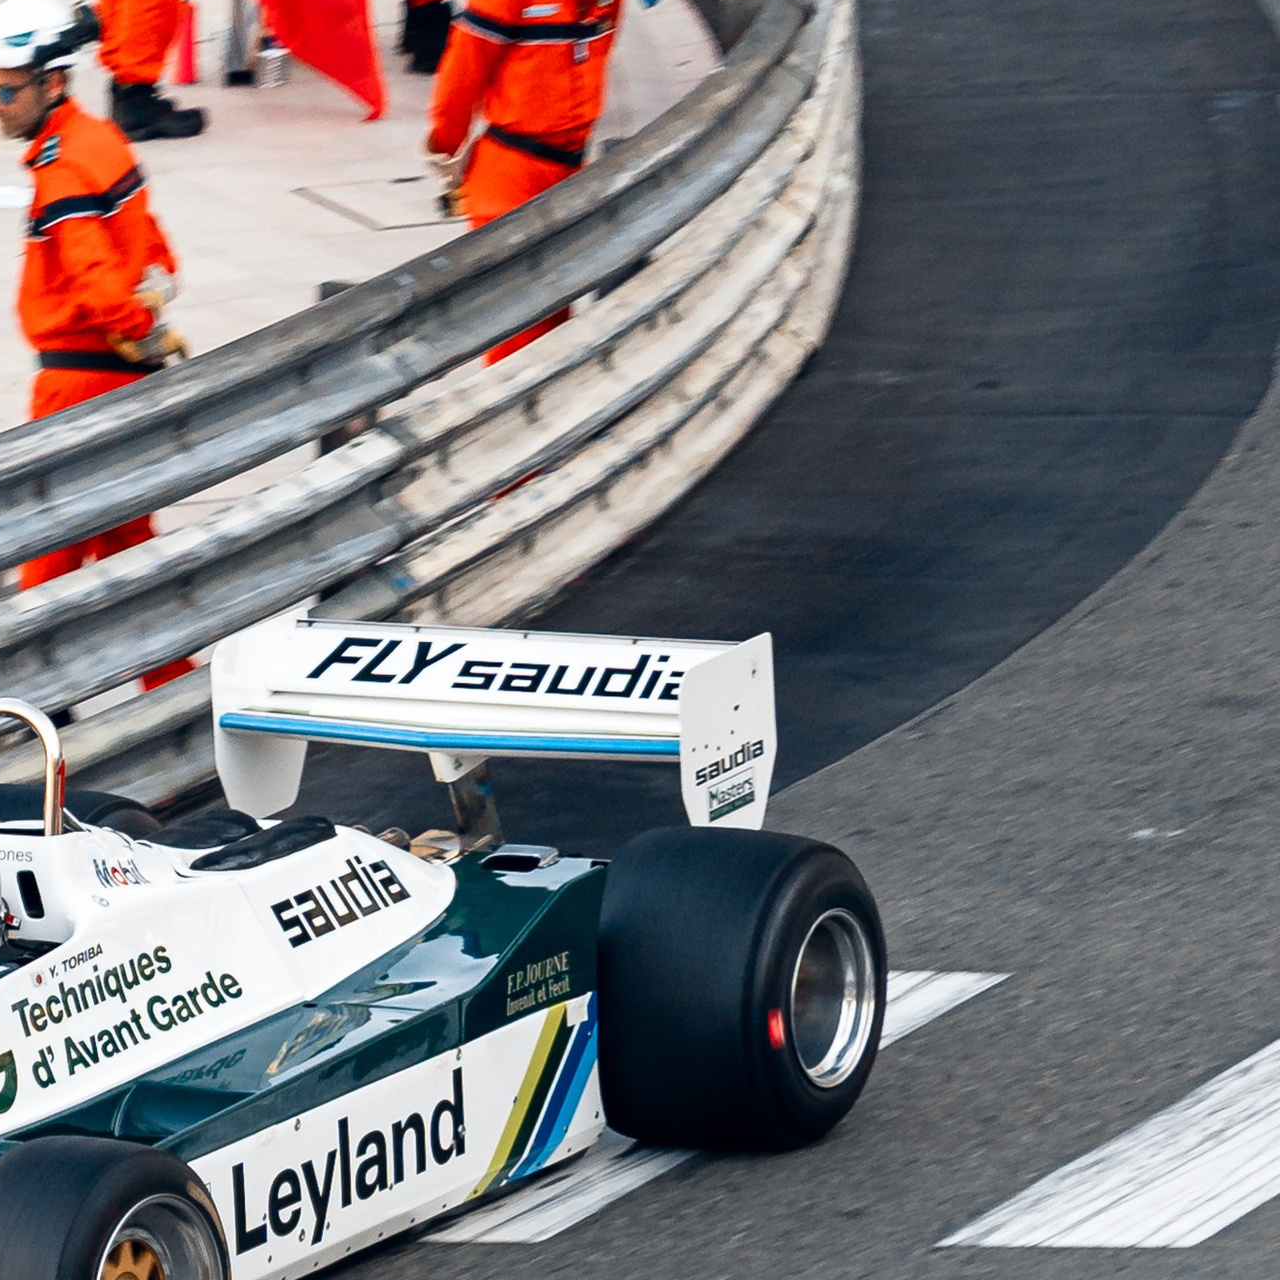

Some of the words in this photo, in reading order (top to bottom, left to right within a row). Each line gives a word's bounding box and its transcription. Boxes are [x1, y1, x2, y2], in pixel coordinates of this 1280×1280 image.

[306, 637, 467, 685] FLY
[695, 739, 764, 786] saudia
[708, 776, 754, 810] Masters
[93, 858, 151, 889] Mobil
[270, 855, 412, 949] saudia
[48, 965, 59, 979] Y.
[61, 943, 104, 973] TORIBA
[11, 945, 172, 1038] Techniques
[537, 983, 547, 1003] et
[67, 1009, 151, 1076] Avant
[147, 971, 243, 1032] Garde
[231, 1066, 466, 1256] Leyland
